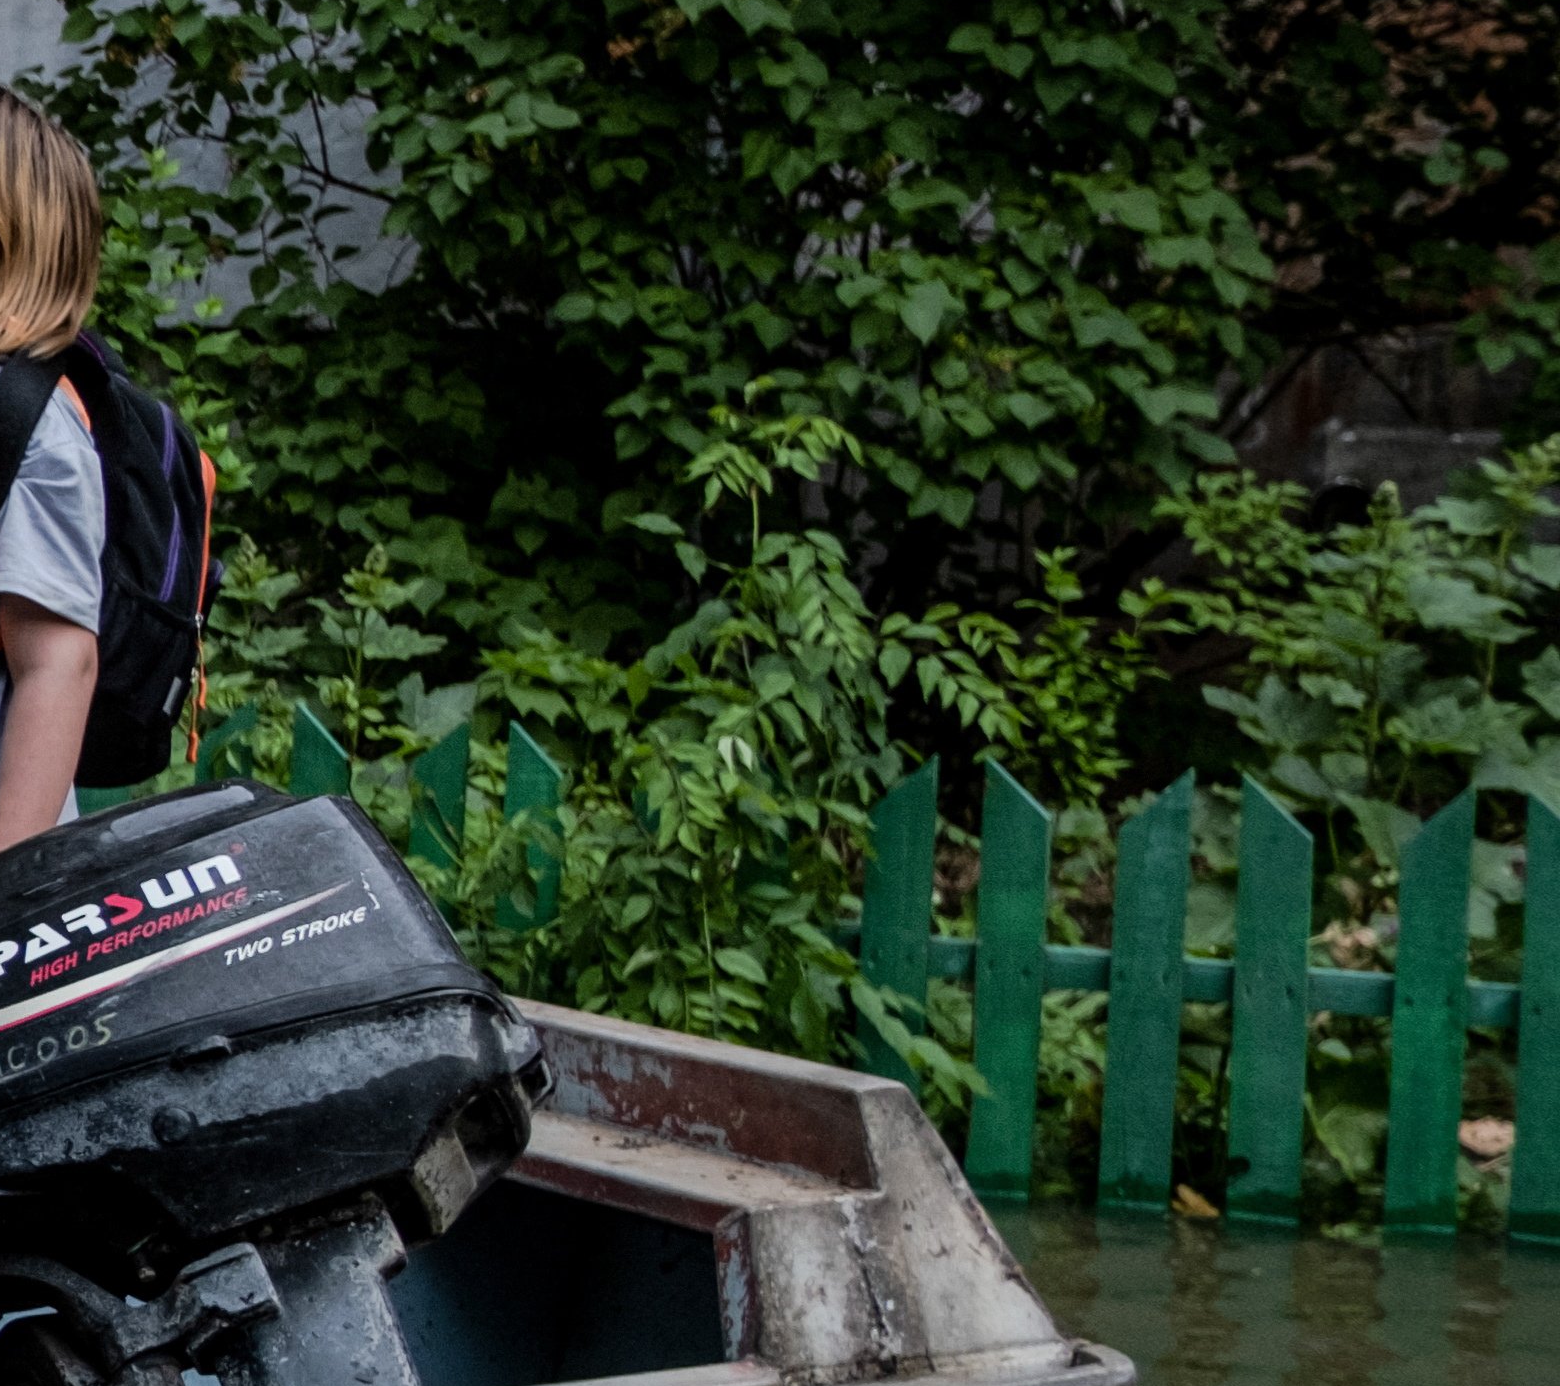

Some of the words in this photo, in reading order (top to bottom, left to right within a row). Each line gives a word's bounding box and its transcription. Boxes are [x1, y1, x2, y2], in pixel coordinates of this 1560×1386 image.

[29, 952, 78, 987] HIGH
[86, 886, 248, 962] PERFORMANCE
[224, 938, 274, 966] TWO
[281, 907, 367, 948] STROKE
